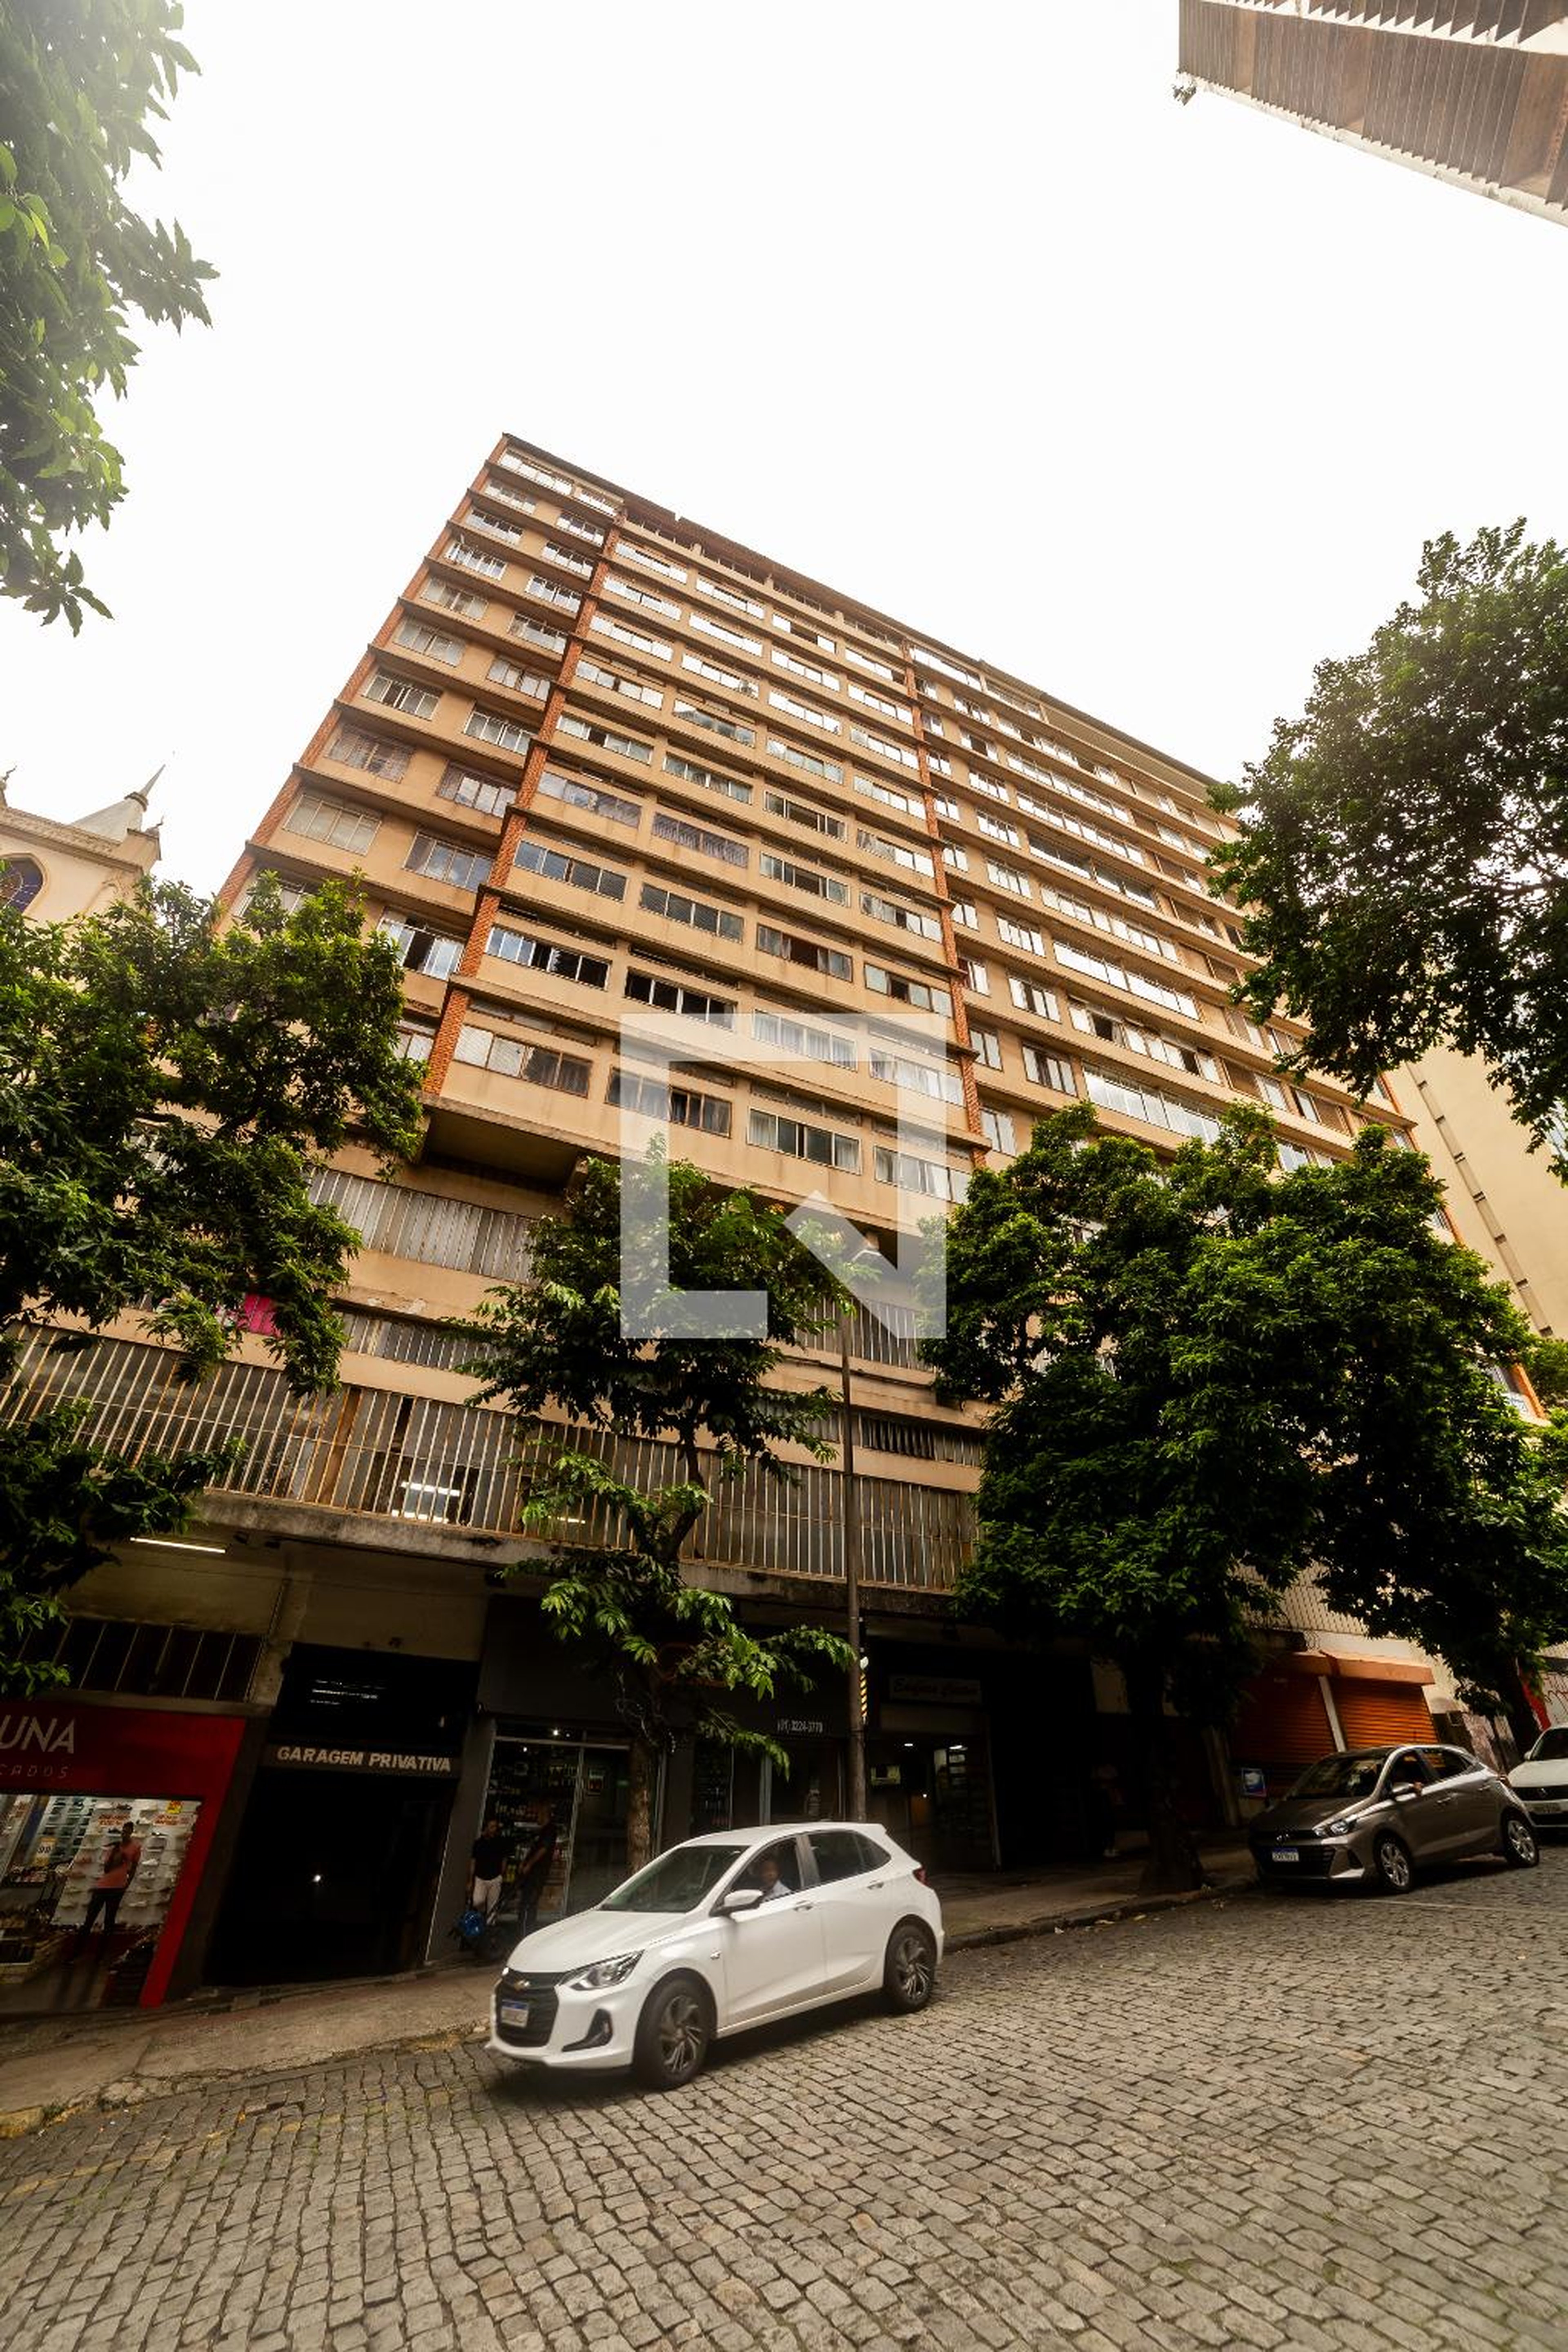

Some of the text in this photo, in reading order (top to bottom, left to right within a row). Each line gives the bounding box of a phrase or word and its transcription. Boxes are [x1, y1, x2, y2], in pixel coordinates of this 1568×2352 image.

[0, 1715, 74, 1754] UNA
[277, 1746, 452, 1772] GARAGEM PRIVATIVA
